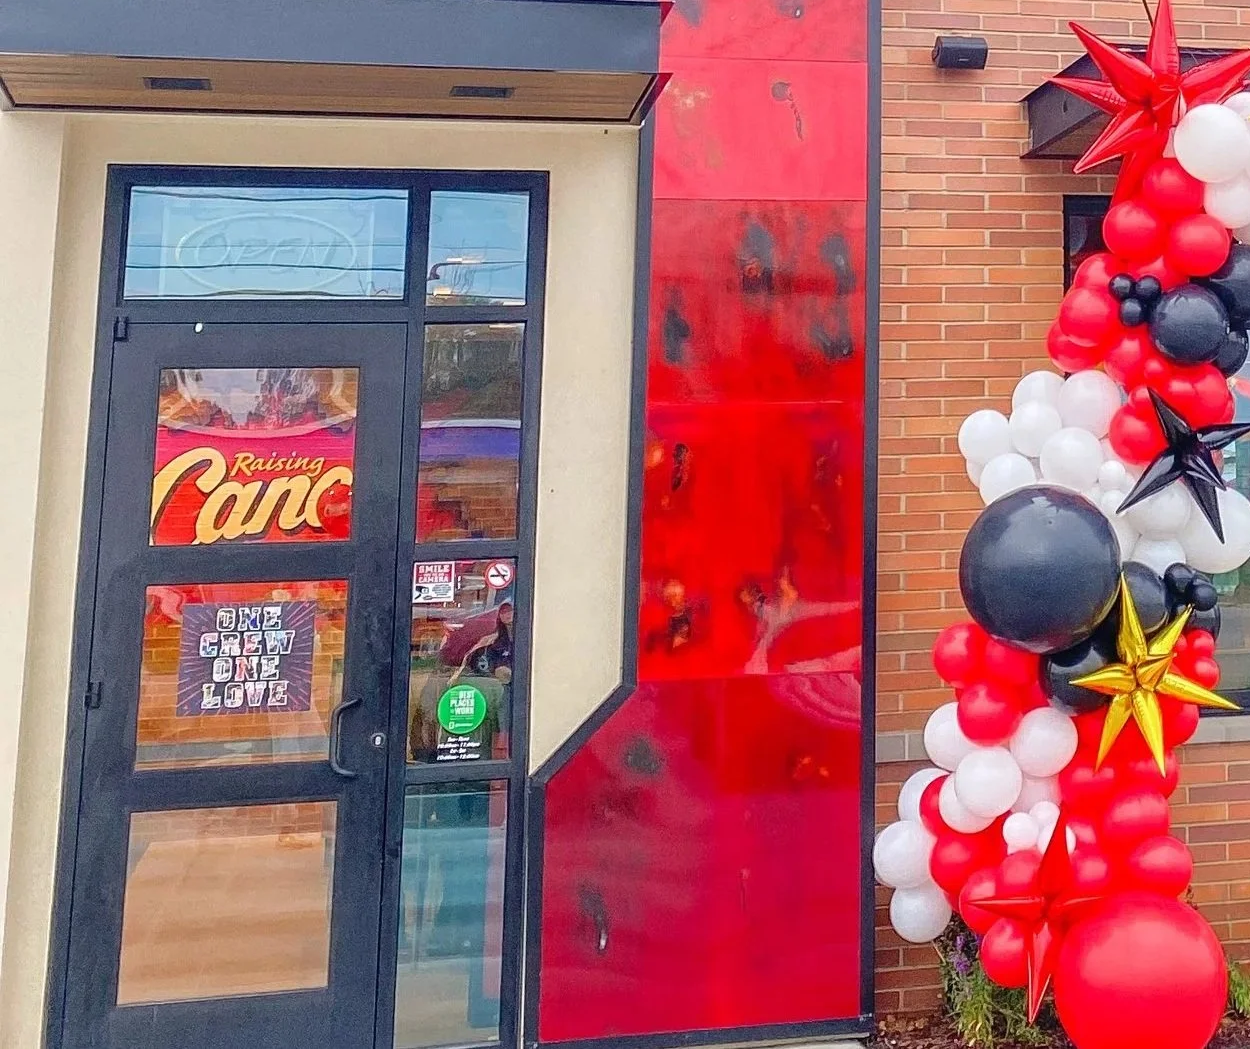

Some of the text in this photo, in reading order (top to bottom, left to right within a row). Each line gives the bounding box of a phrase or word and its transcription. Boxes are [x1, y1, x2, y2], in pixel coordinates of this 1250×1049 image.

[230, 451, 325, 477] Raising
[418, 564, 450, 574] SMILE
[216, 606, 282, 632] ONE
[200, 630, 296, 657] CREW
[212, 655, 280, 682] ONE
[200, 680, 289, 709] LOVE
